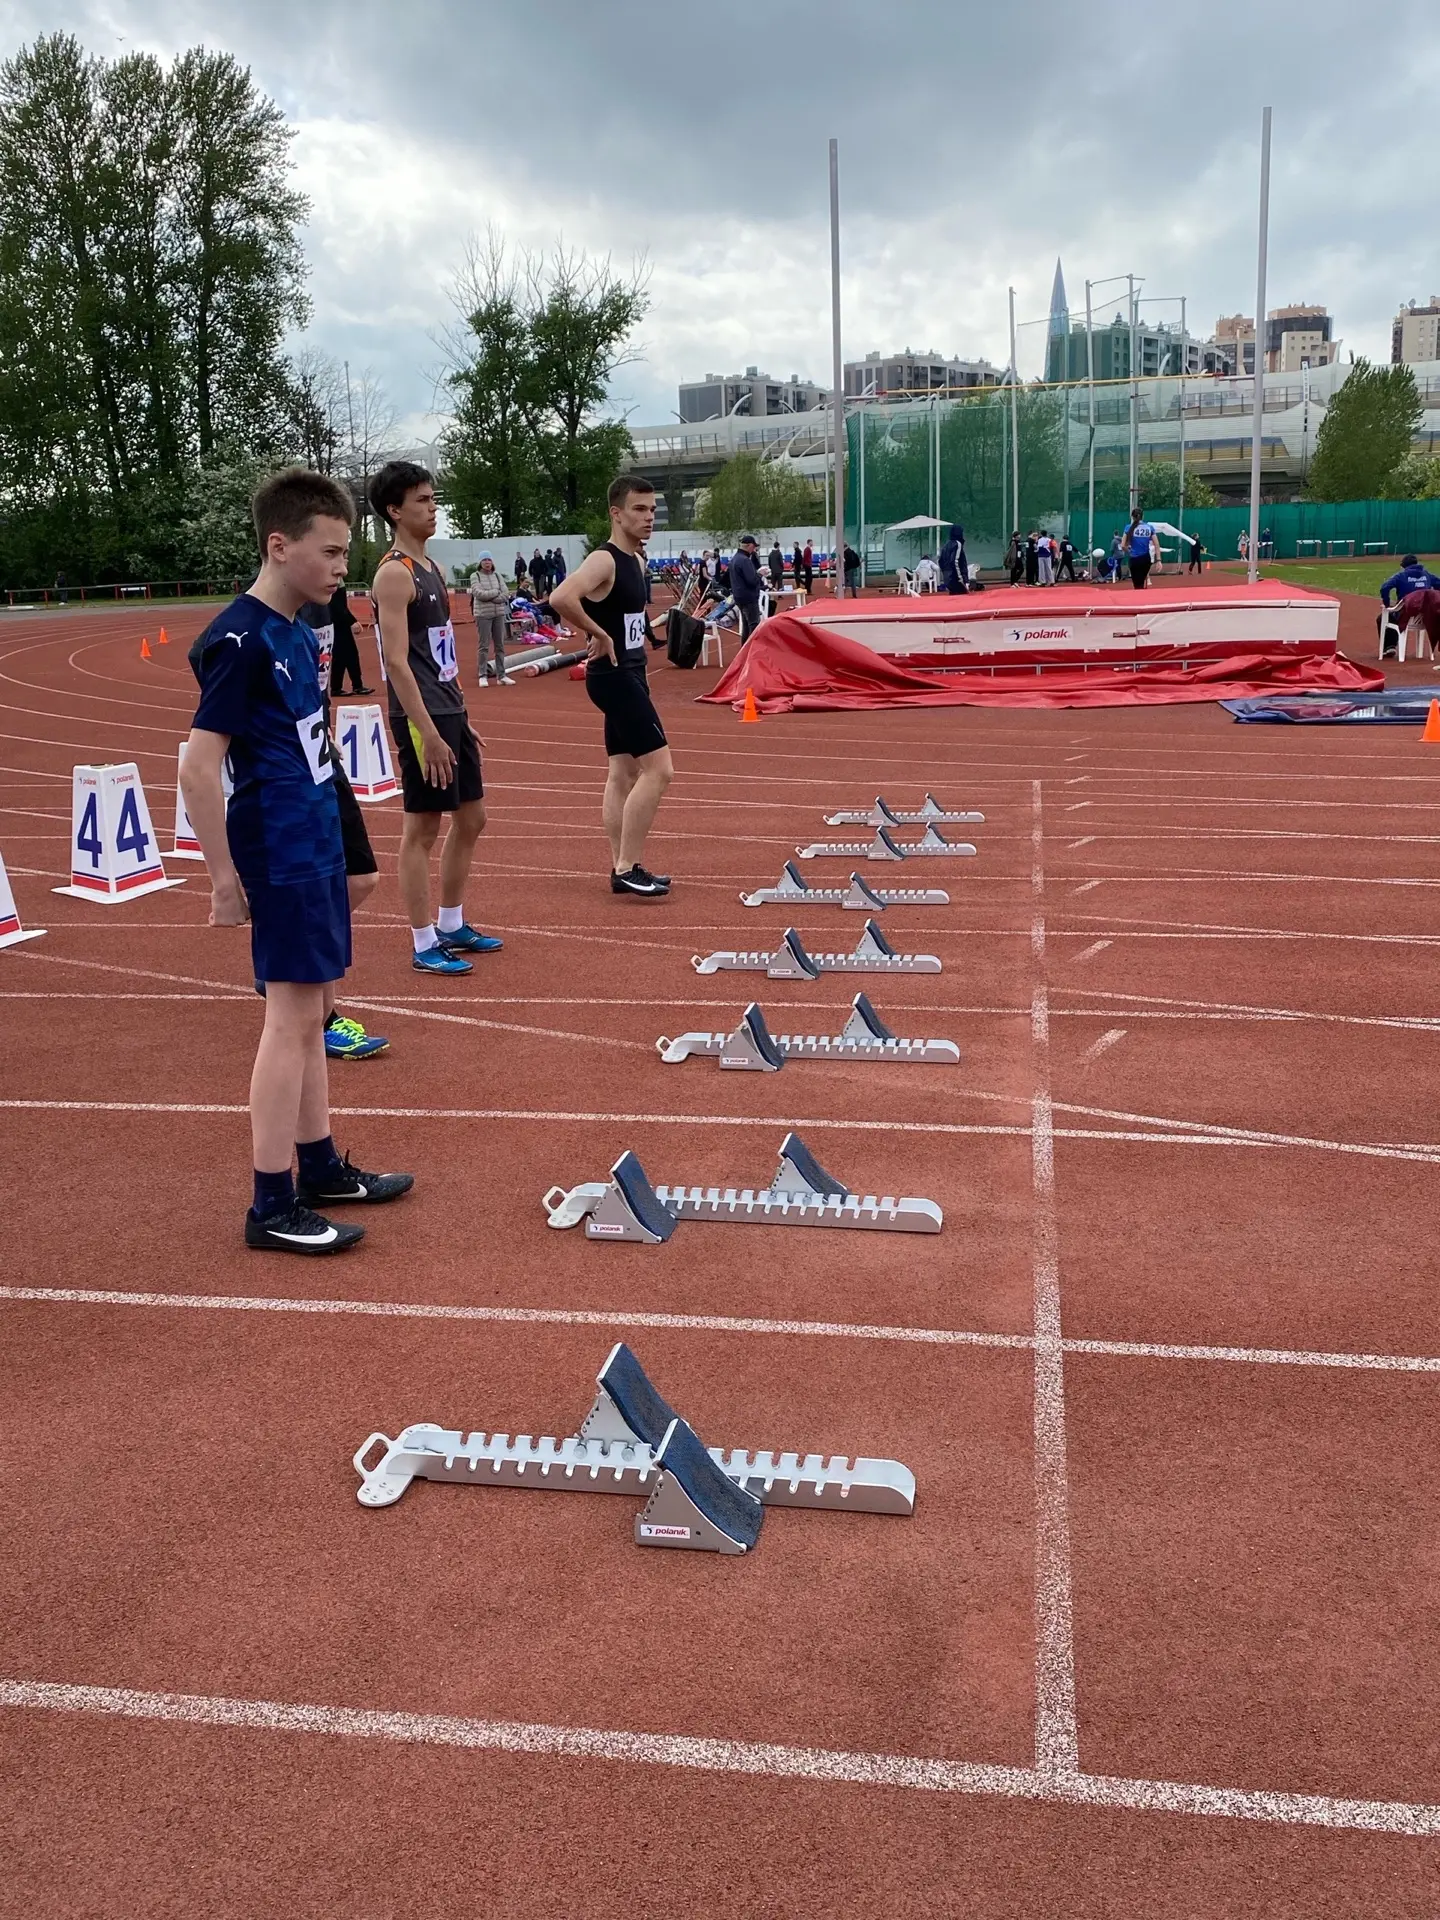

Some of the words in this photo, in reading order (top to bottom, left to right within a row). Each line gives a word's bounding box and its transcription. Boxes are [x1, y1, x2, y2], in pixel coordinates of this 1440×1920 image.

[1024, 629, 1068, 641] polanik
[342, 724, 357, 778] 1
[371, 722, 386, 776] 1
[78, 792, 102, 868] 4
[116, 788, 149, 862] 4
[655, 1528, 686, 1536] polanik
